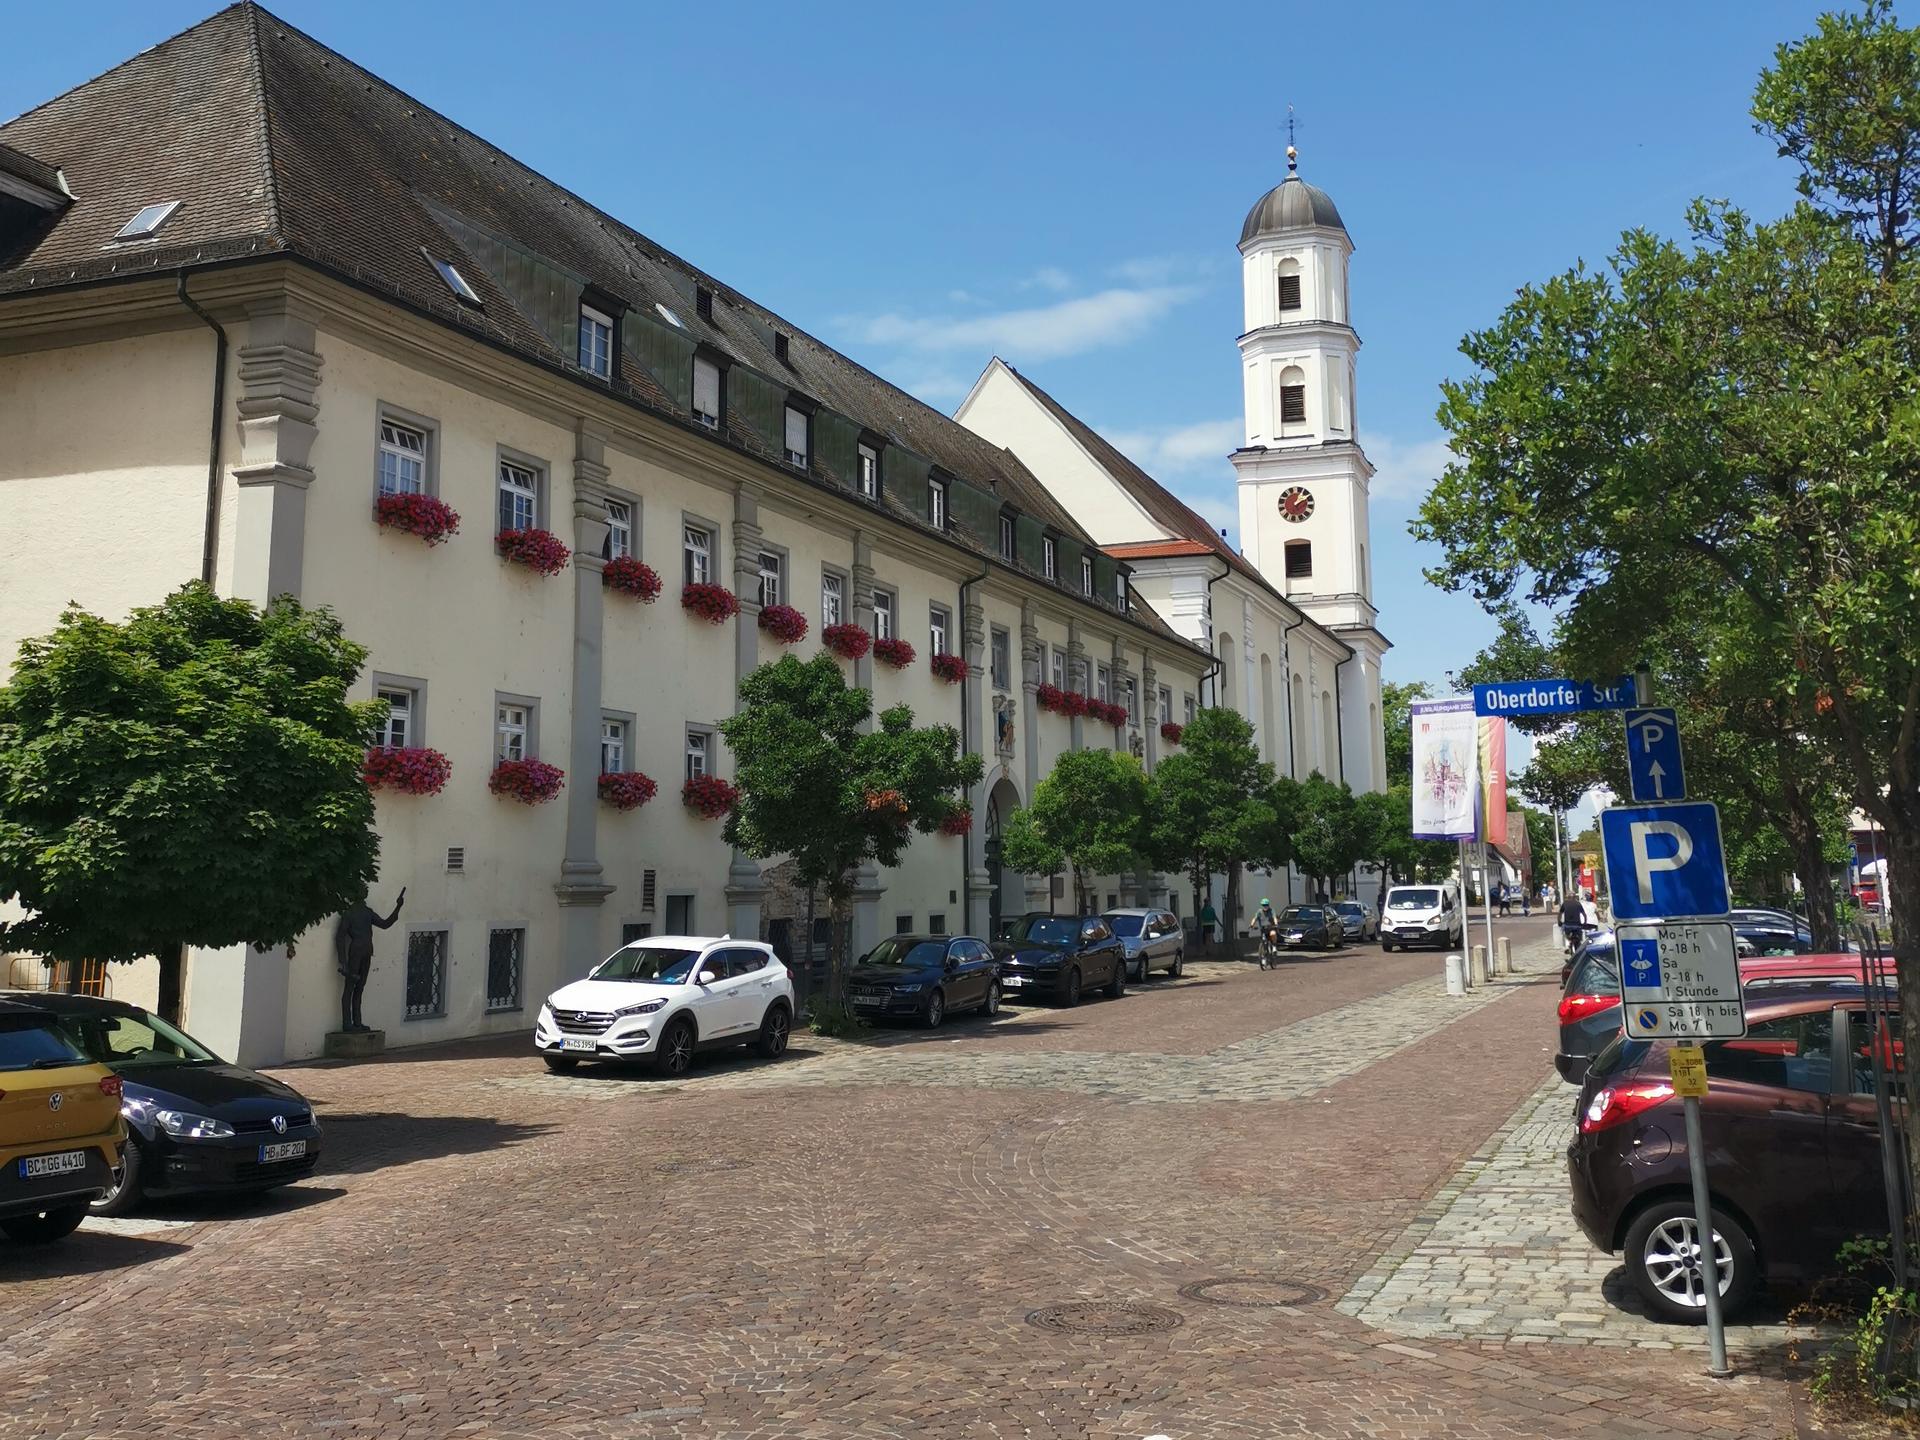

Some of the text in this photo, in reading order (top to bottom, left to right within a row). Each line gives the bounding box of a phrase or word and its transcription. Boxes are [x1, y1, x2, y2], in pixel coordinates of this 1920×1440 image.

[1486, 684, 1624, 710] Oberdorfer Str.
[1642, 725, 1664, 753] P
[1630, 820, 1694, 904] P
[1659, 928, 1699, 940] Mo-Fr
[1660, 943, 1701, 954] 9-18 h
[1662, 958, 1678, 968] Sa
[1638, 972, 1646, 982] P
[1663, 972, 1704, 983] 9-18 h
[1665, 985, 1719, 997] 1 Stunde
[1668, 1005, 1738, 1017] Sa 18 h bis
[1669, 1020, 1713, 1031] Mo 7 h
[265, 1142, 305, 1159] HB BF 201
[27, 1153, 84, 1174] BC GG 4410
